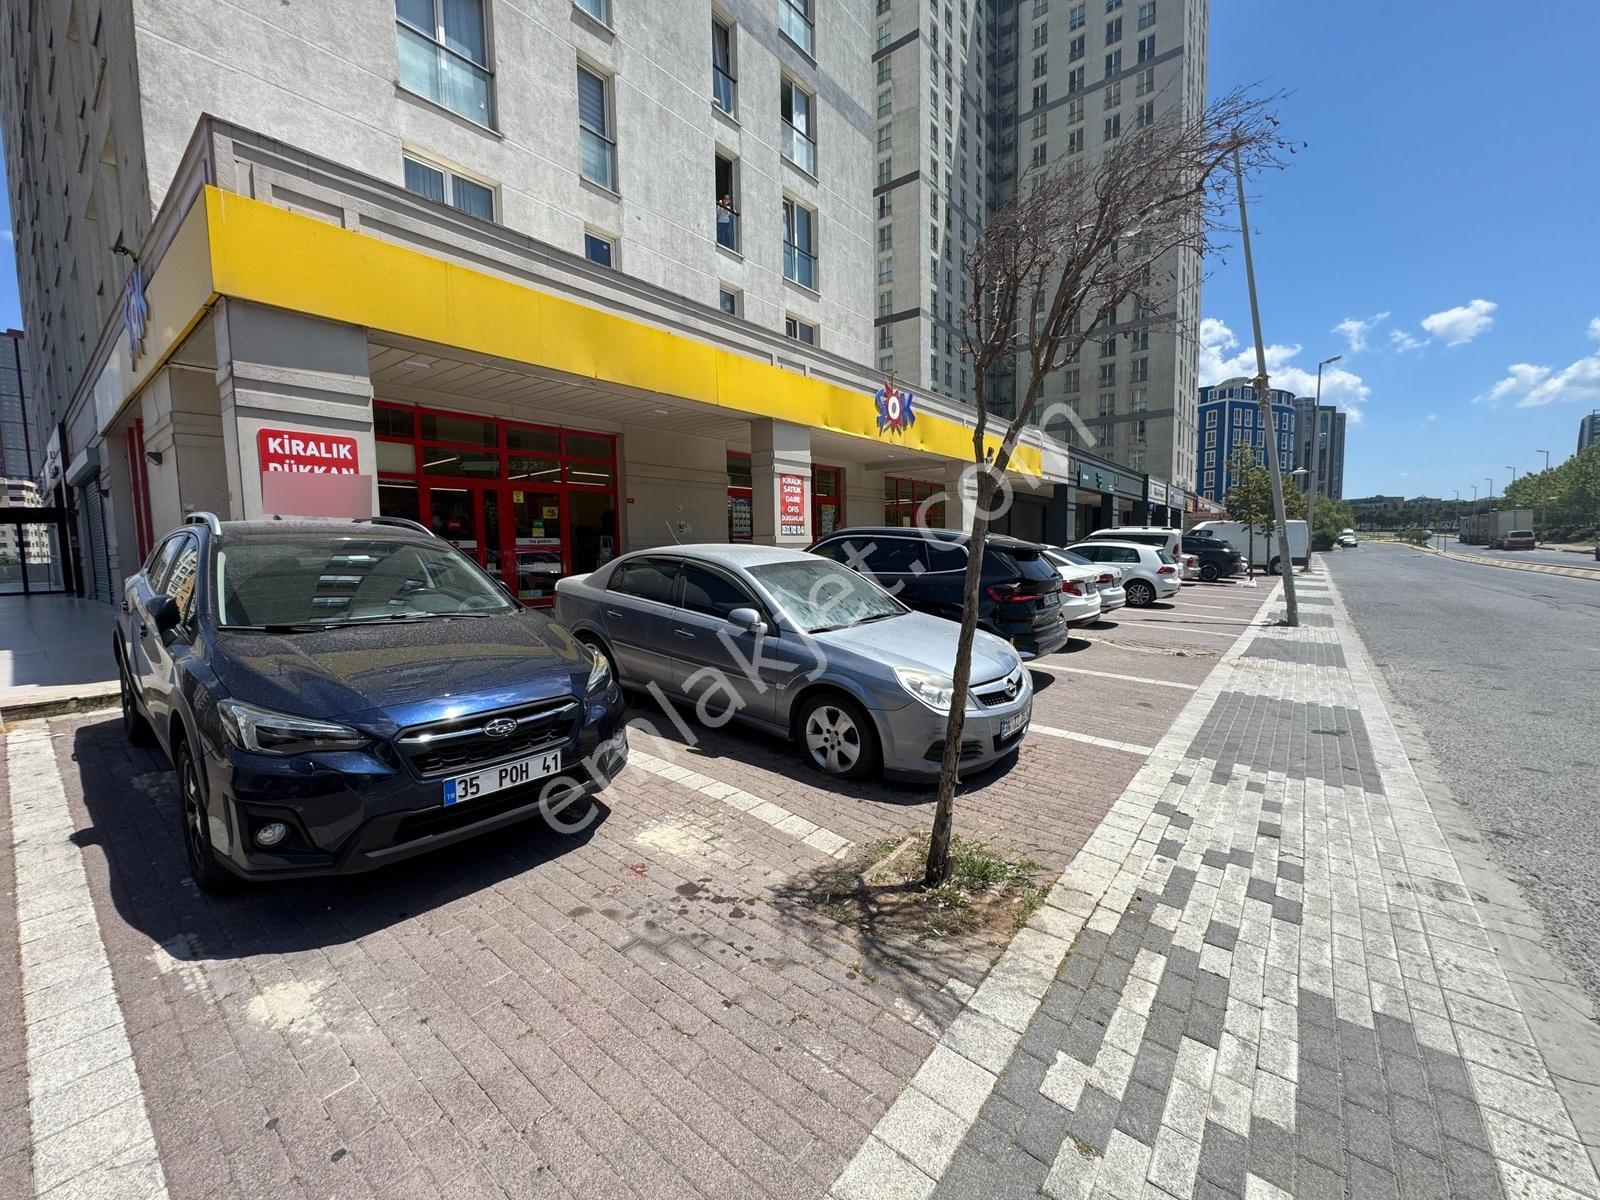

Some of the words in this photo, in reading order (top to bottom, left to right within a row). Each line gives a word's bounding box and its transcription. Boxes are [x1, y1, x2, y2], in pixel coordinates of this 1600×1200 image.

[268, 435, 353, 460] KİRALIK
[446, 792, 456, 801] TR
[457, 775, 481, 799] 35
[499, 762, 529, 787] POH
[542, 753, 559, 774] 41
